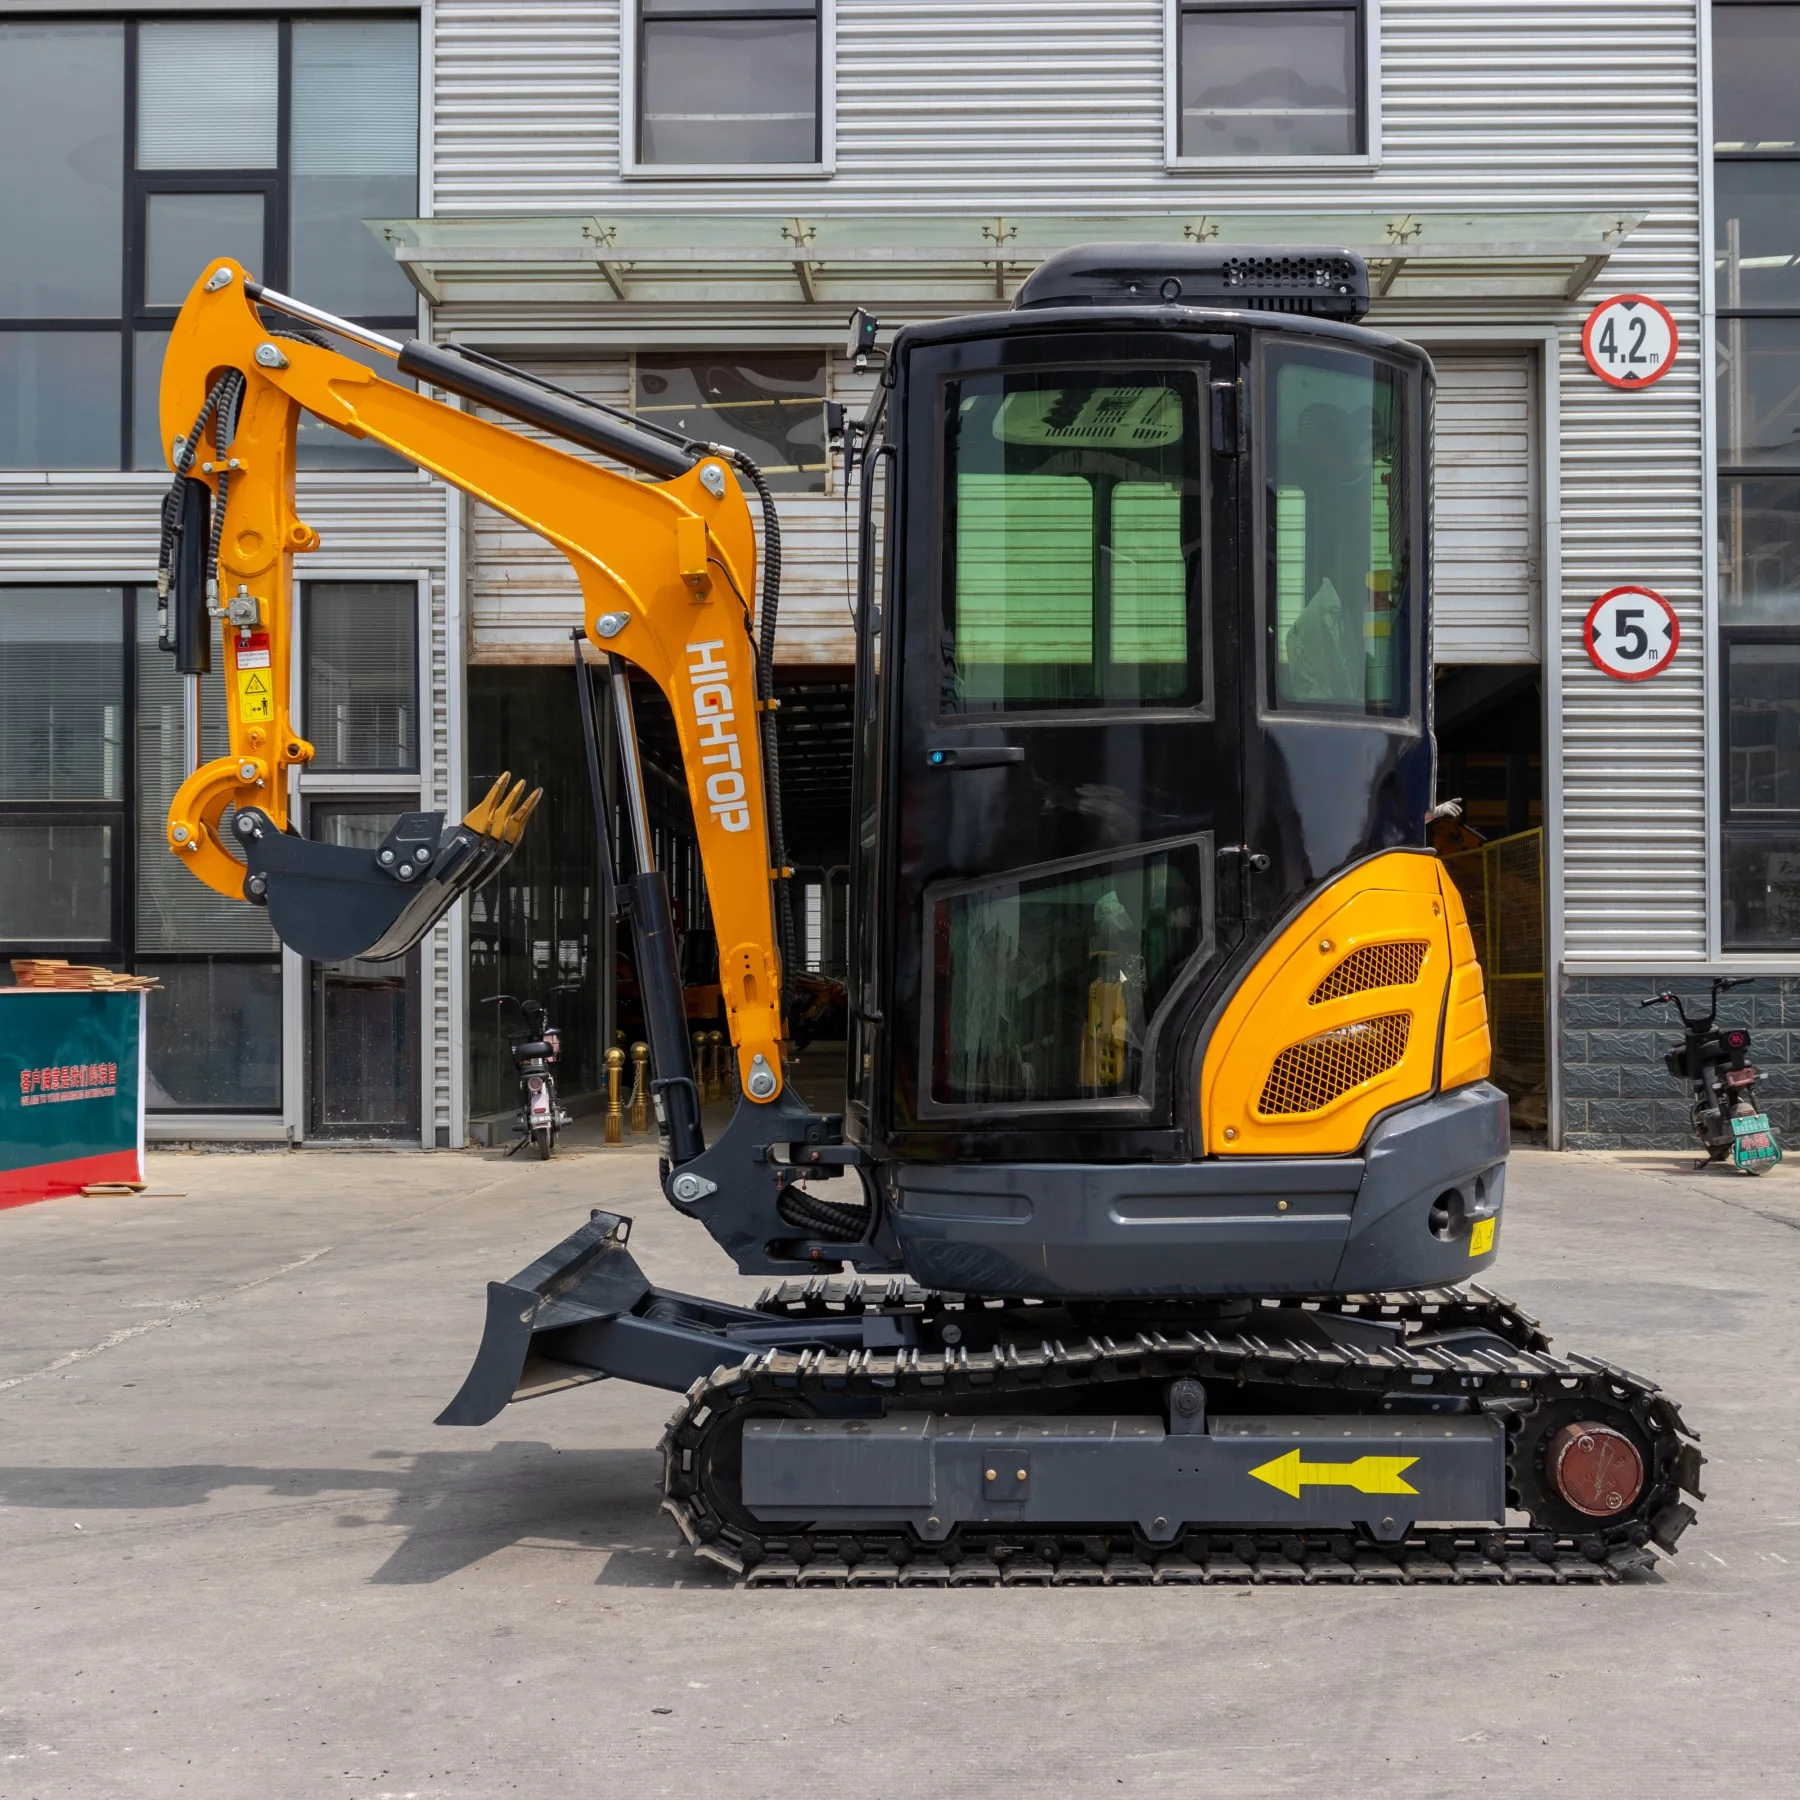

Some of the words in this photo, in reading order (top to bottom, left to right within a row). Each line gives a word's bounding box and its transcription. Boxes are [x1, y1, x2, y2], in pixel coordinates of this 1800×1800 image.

[686, 639, 750, 833] HIGHTOP
[20, 1062, 117, 1093] 客户满意是我们的宗旨
